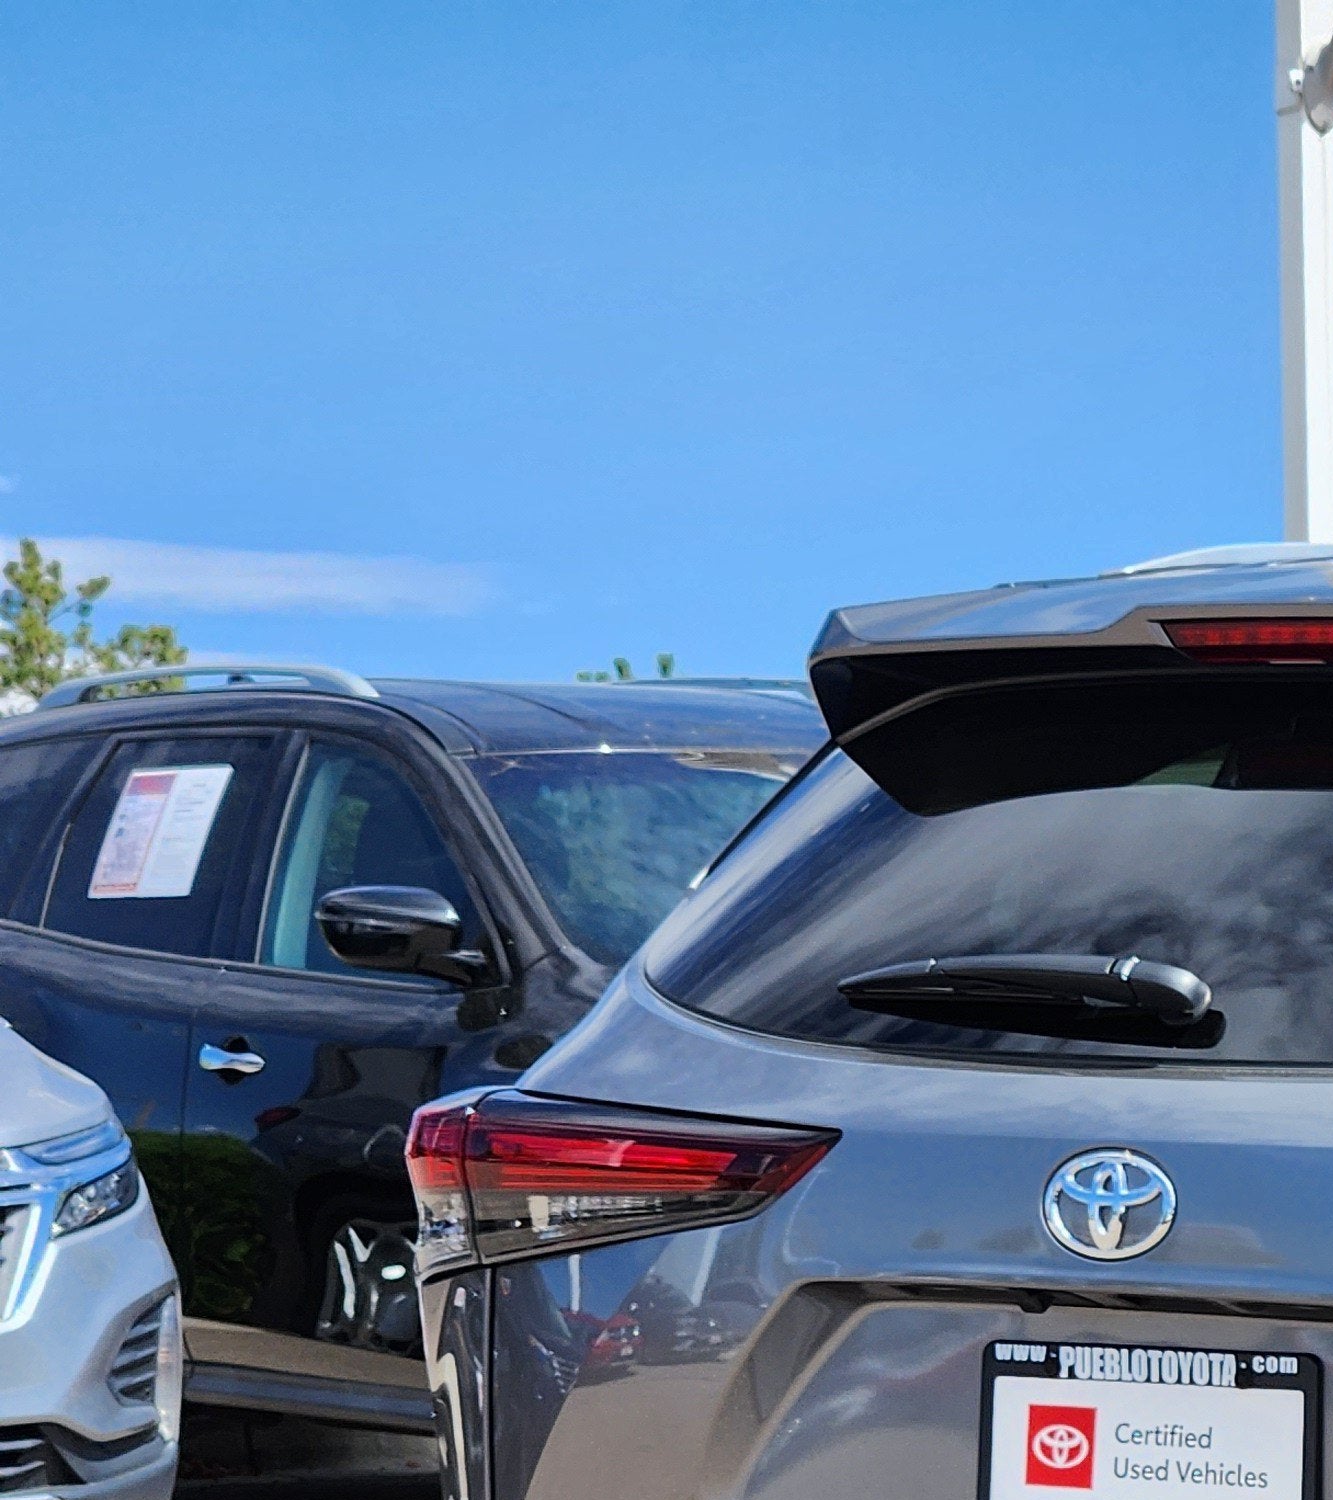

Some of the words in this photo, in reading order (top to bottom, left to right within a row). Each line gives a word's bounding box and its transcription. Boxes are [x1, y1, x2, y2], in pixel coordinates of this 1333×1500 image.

[1114, 1422, 1213, 1450] Certified
[1113, 1456, 1169, 1483] Used
[1176, 1460, 1269, 1489] Vehicles
